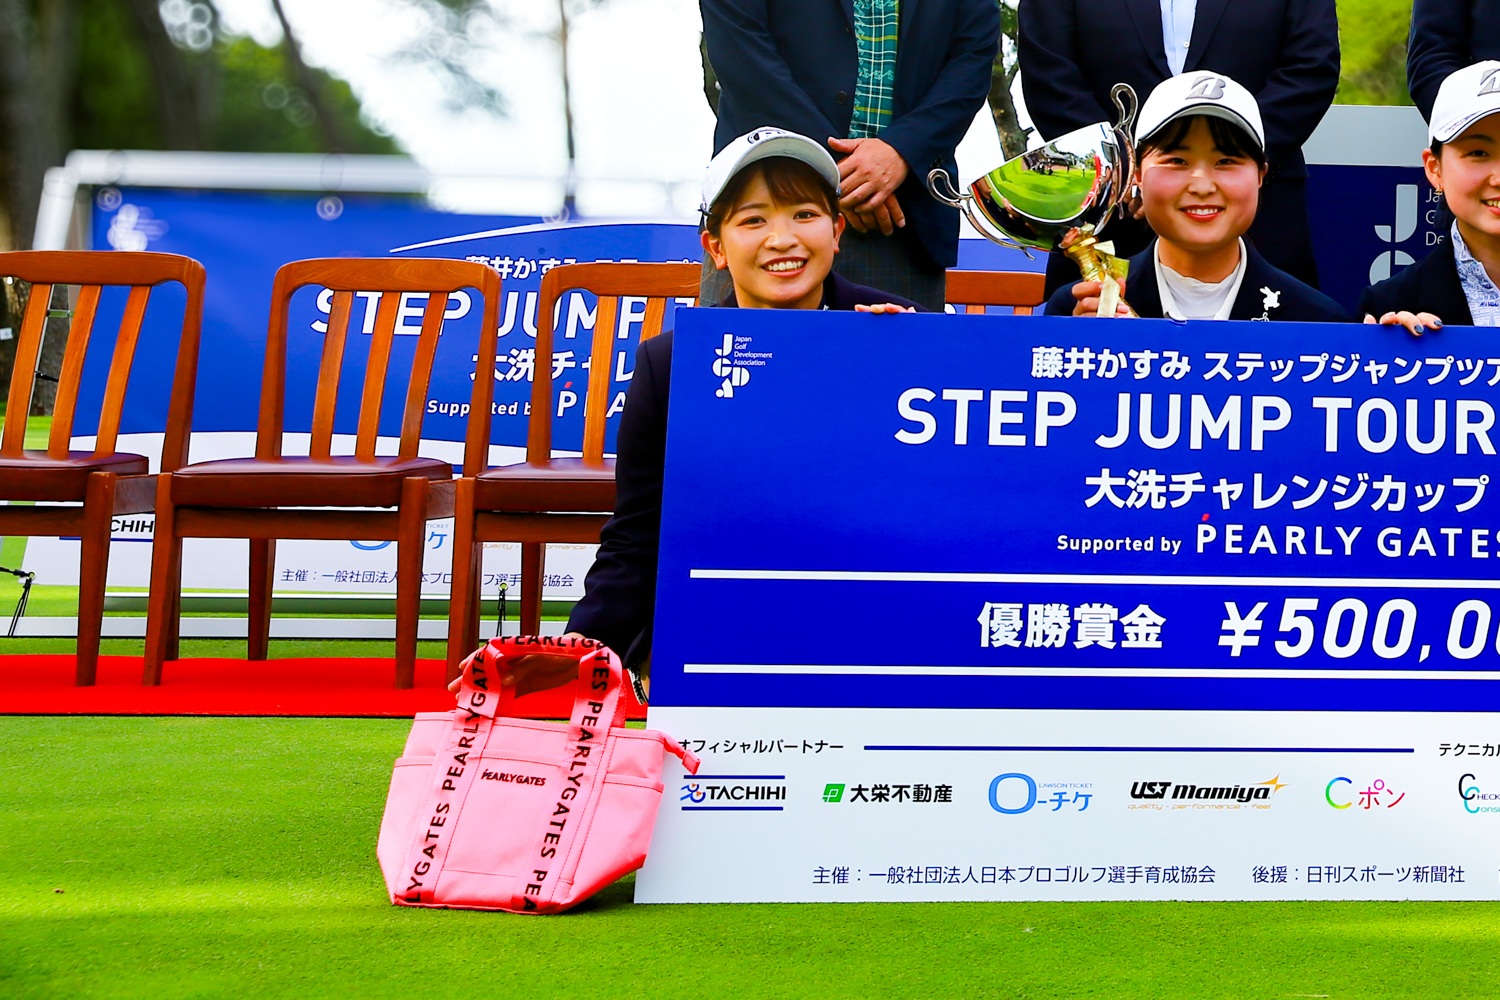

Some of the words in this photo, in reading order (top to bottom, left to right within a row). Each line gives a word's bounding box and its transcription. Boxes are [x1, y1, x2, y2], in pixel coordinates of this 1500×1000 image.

[1031, 346, 1191, 381] 藤井かすみ
[427, 400, 518, 418] Suppted
[894, 387, 1078, 447] STEP
[1095, 392, 1292, 451] JUMP
[1312, 396, 1497, 456] TOUR
[1084, 468, 1490, 514] 大洗チャレンジカップ
[1056, 533, 1155, 555] Supported
[1160, 535, 1182, 556] by
[1196, 520, 1362, 556] PEARLY
[977, 602, 1167, 650] 優勝賞金
[442, 650, 486, 791] PEARLYGATE
[679, 739, 844, 755] オフィシャルパートナー
[481, 769, 546, 787] PEARLYGATES
[541, 701, 603, 859] PEARLYGATES
[706, 785, 786, 801] TACHIHI
[850, 783, 953, 803] 大栄不動産
[1127, 803, 1163, 811] quality
[1171, 803, 1241, 811] performance
[405, 803, 450, 903] LYGATES
